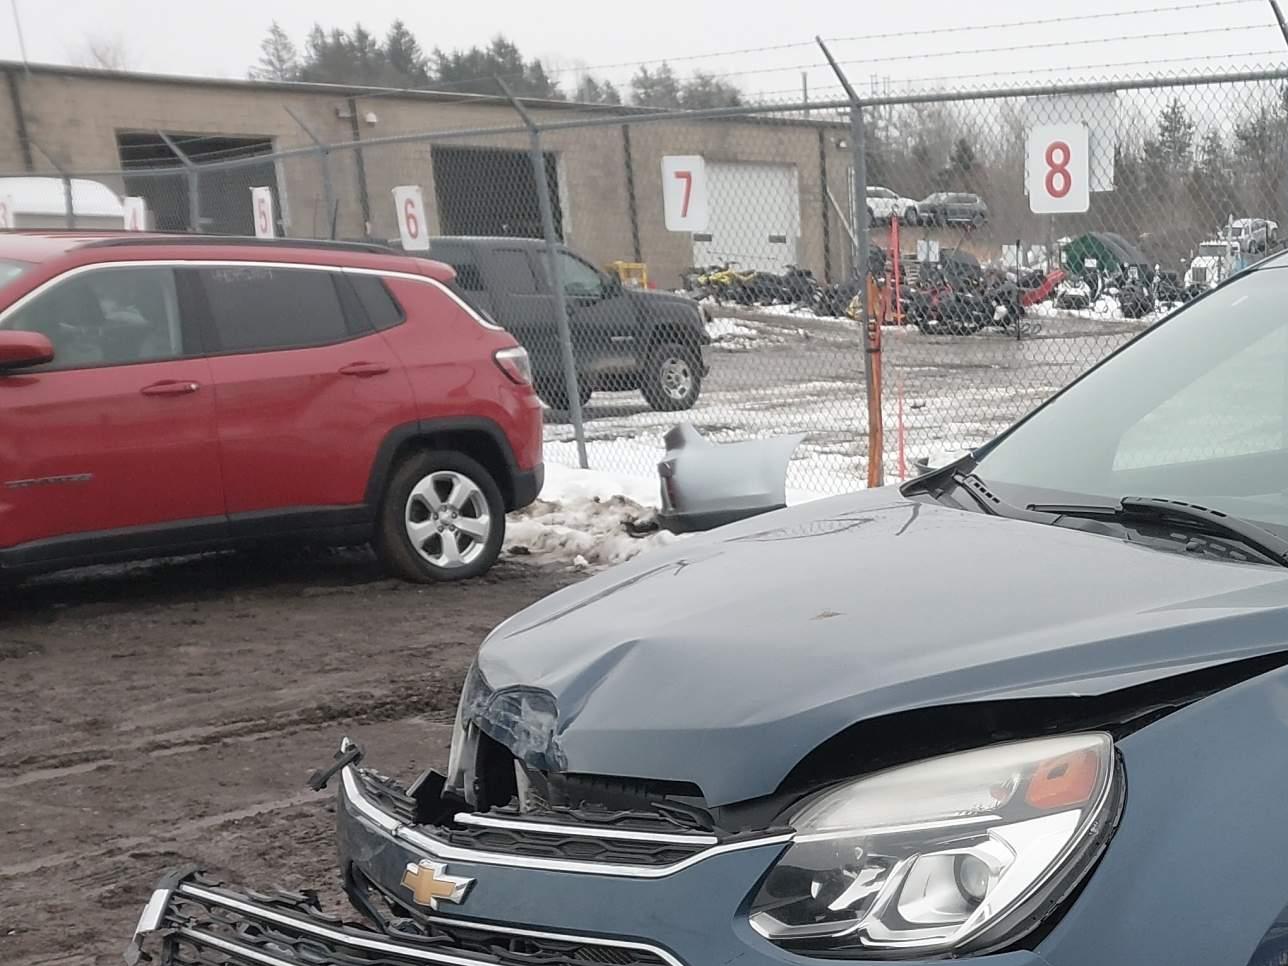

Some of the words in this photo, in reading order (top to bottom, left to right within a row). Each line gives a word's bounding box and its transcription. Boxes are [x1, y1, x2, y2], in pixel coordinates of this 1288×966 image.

[1045, 141, 1072, 198] 8
[257, 199, 268, 233] 5
[674, 171, 692, 217] 7
[405, 198, 418, 240] 6
